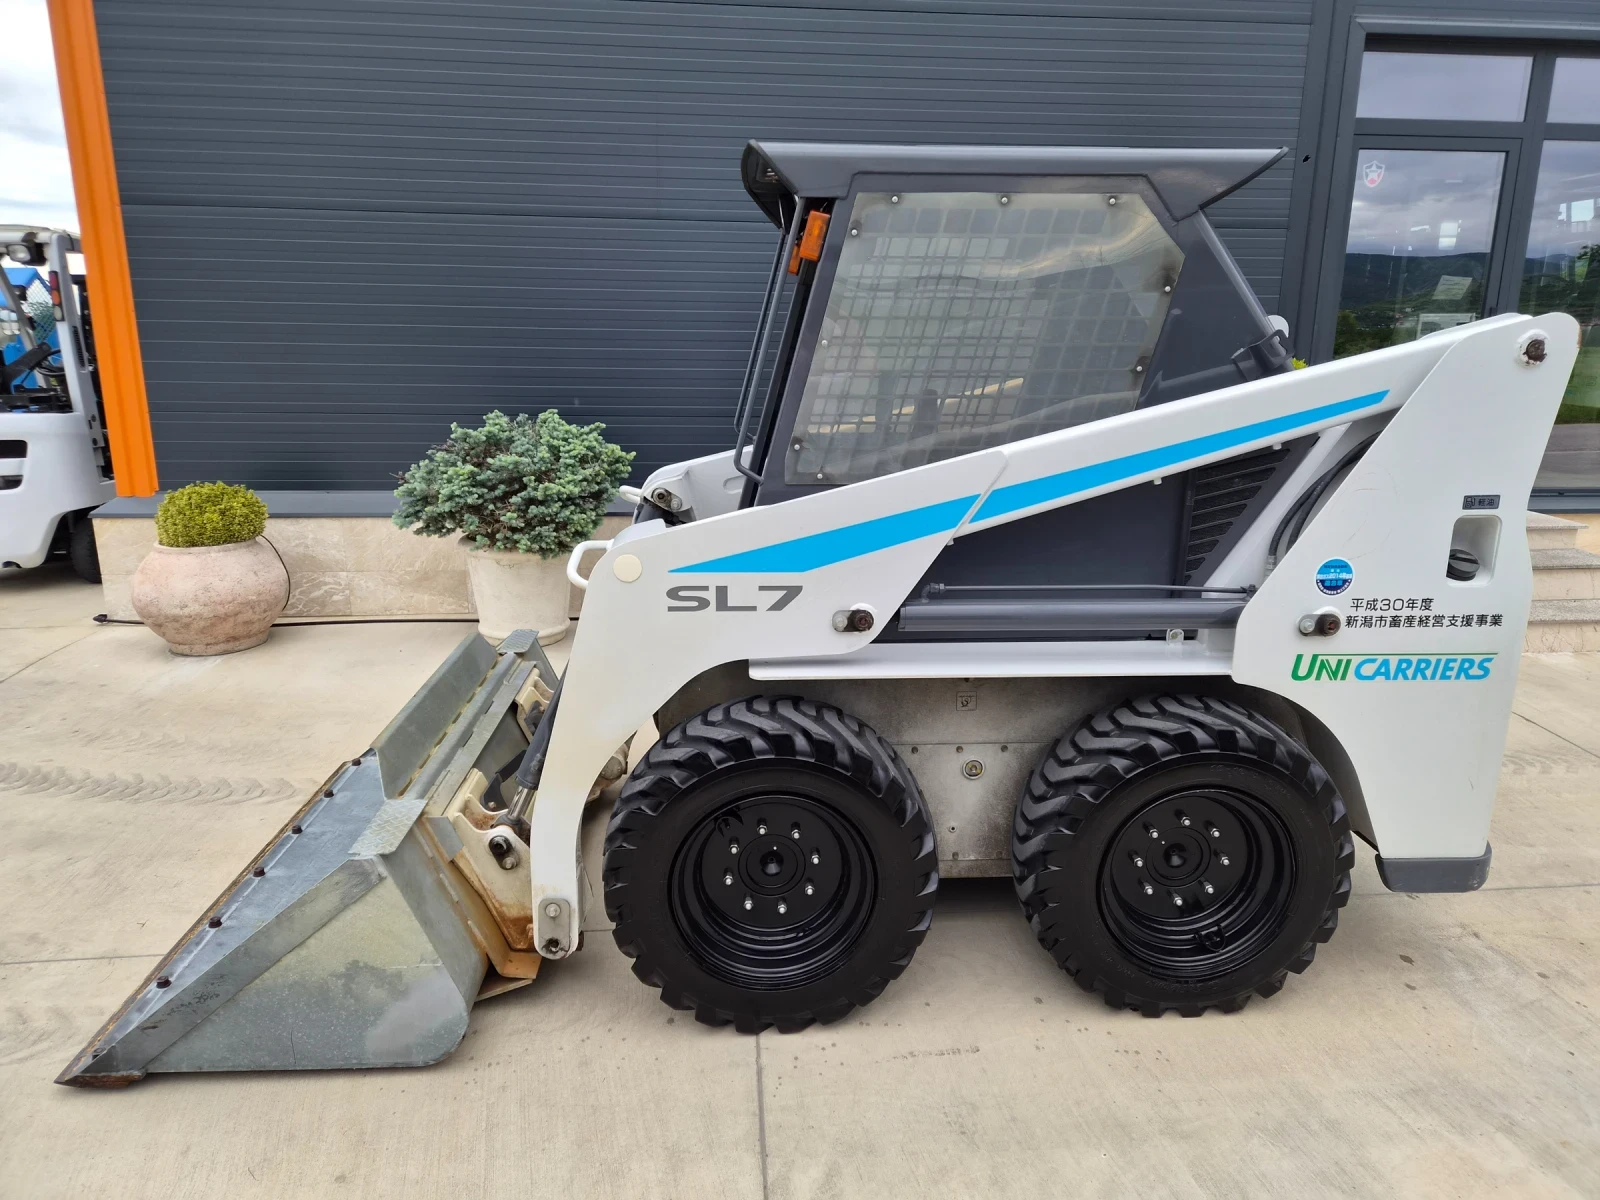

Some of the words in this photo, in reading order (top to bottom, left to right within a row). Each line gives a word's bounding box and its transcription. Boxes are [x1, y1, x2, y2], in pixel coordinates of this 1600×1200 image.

[1478, 498, 1495, 507] 軽油
[665, 585, 804, 612] SL7
[1350, 598, 1435, 612] 平成30年度
[1344, 614, 1504, 629] 新潟市畜産経営支援事業
